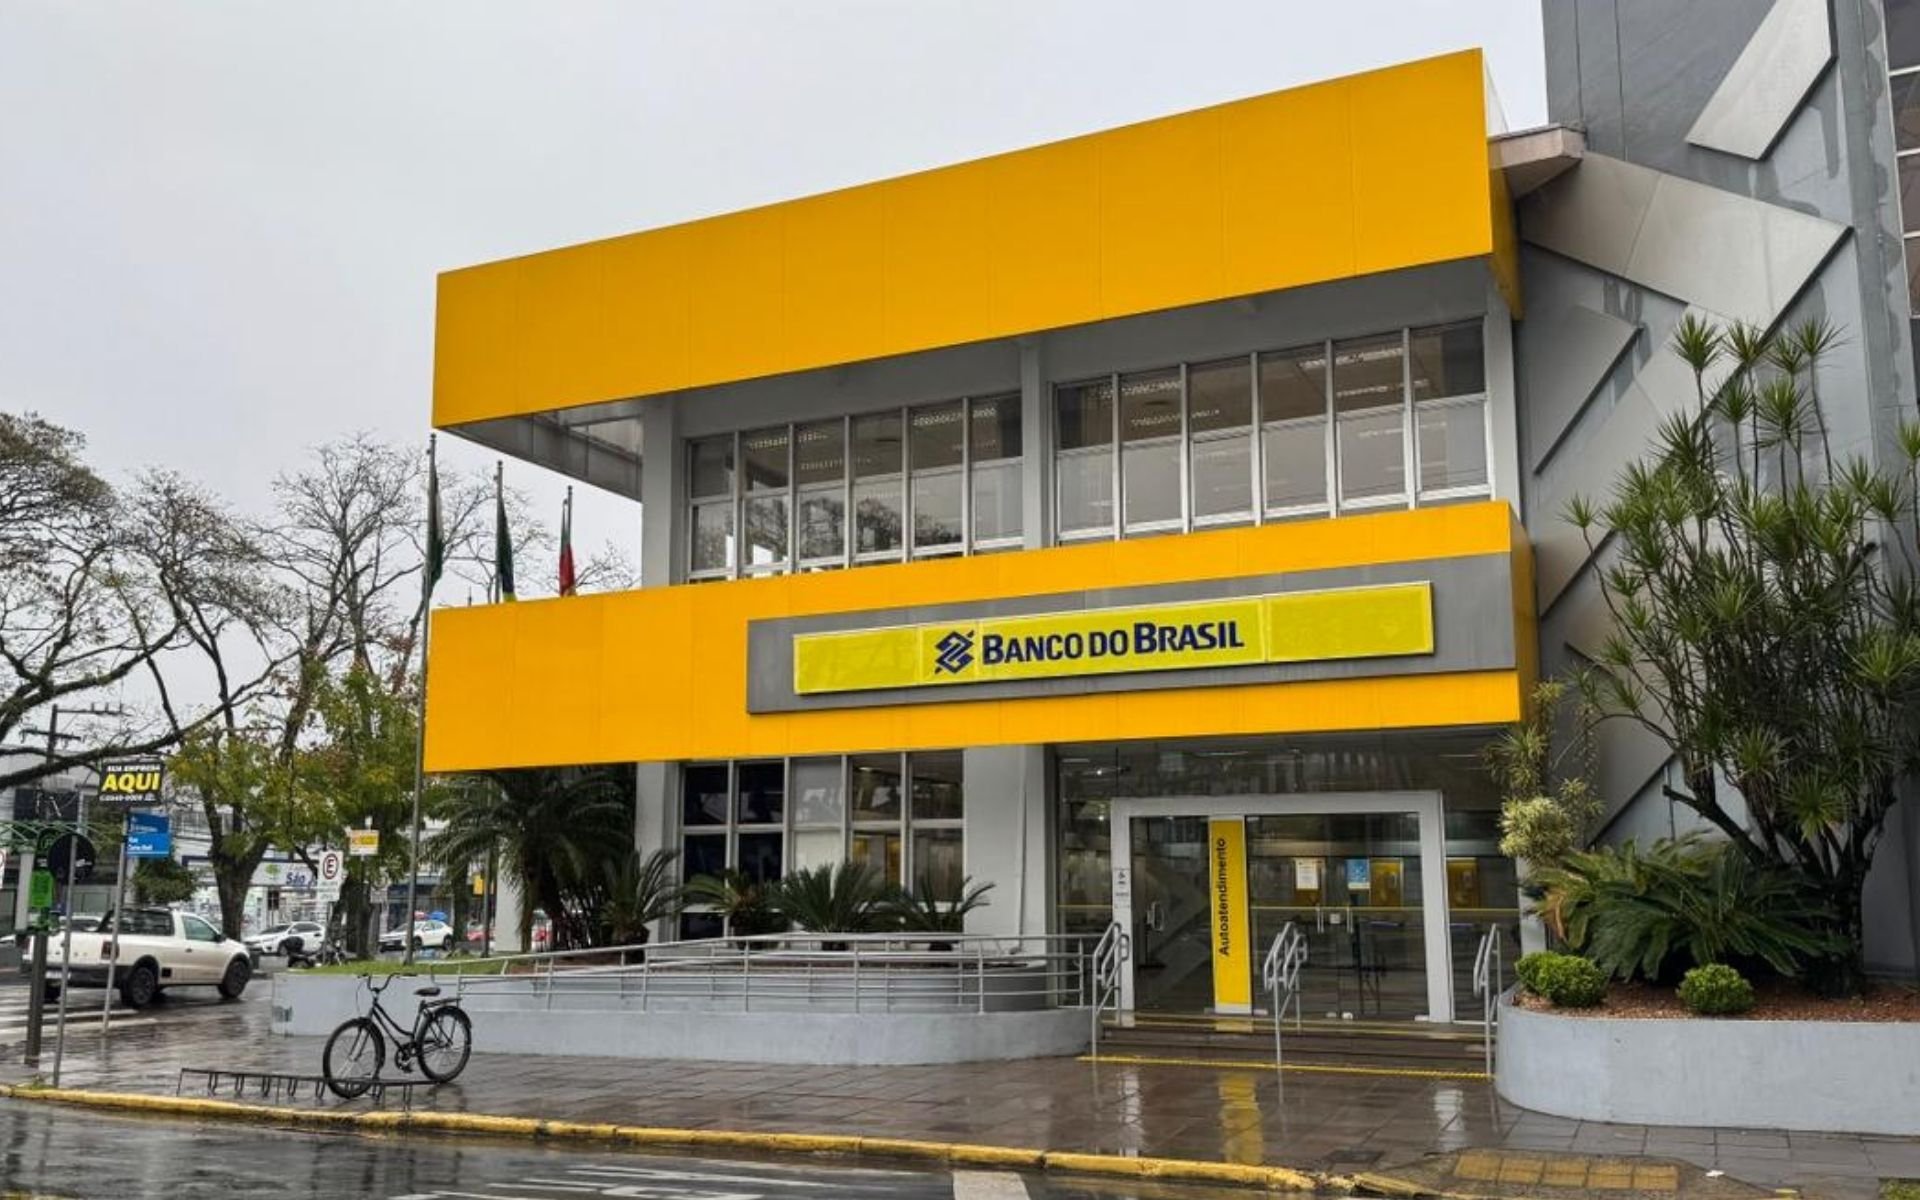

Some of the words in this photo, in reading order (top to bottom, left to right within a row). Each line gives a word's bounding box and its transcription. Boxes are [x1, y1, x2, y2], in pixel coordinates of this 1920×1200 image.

[982, 632, 1083, 665] BANCO
[1088, 629, 1129, 658] DO
[1133, 621, 1244, 654] BRASIL
[101, 772, 160, 793] AQUI
[1216, 838, 1230, 956] Autoatendimento
